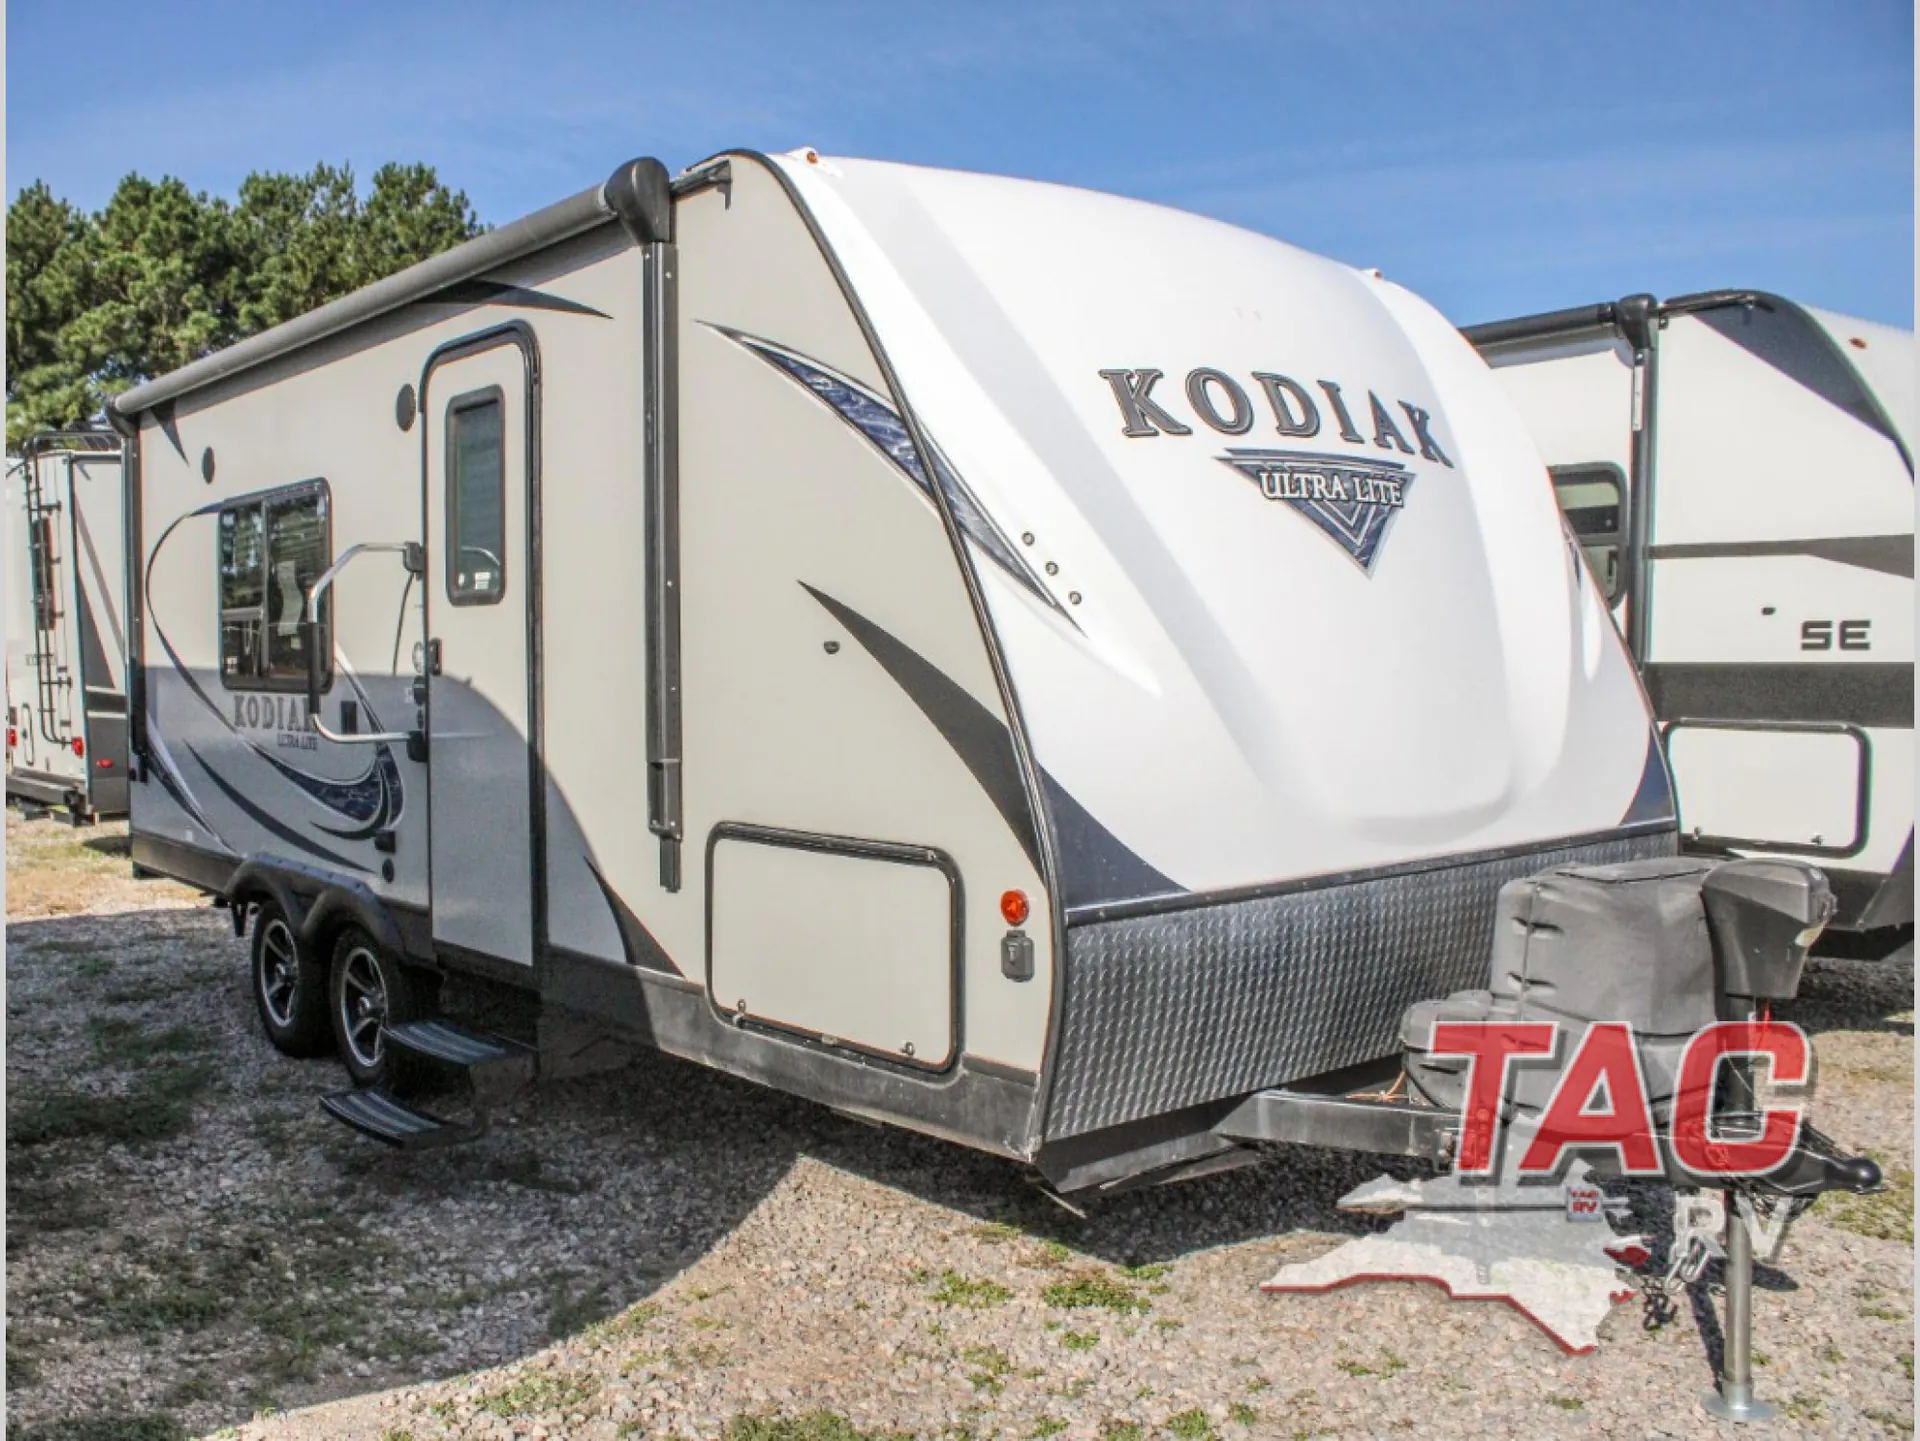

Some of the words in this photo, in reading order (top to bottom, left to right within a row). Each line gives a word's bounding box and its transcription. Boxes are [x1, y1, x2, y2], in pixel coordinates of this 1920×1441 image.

[1098, 367, 1454, 468] KODIAK
[1259, 471, 1349, 500] ULTRA
[1353, 476, 1403, 506] LITE
[1801, 620, 1871, 651] SE
